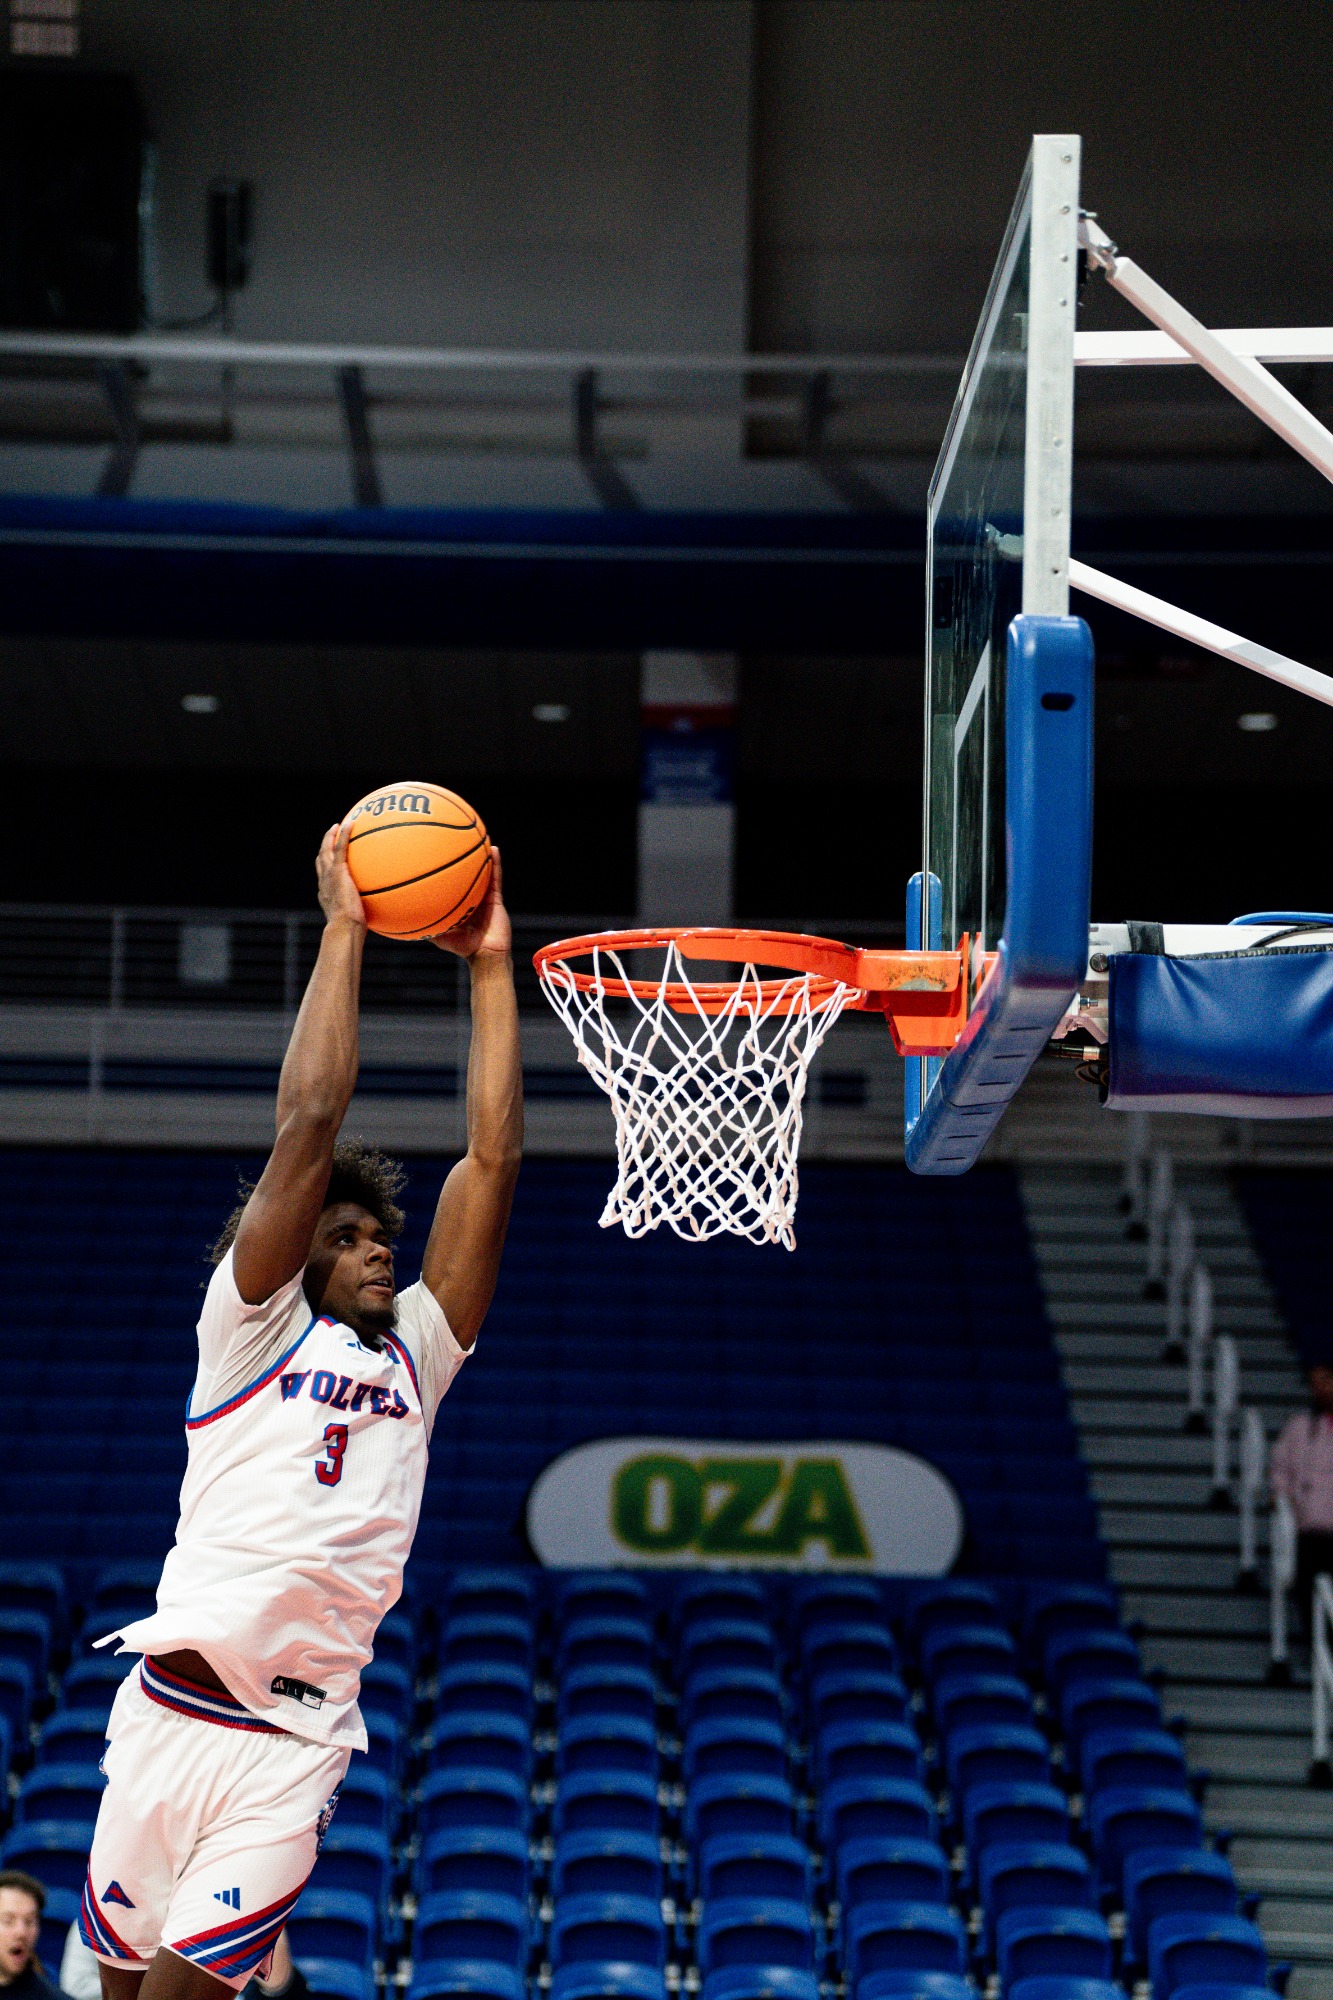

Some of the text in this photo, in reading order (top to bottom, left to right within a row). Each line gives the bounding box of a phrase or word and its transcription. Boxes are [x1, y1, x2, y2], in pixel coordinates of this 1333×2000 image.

[351, 793, 431, 821] Wilso
[279, 1369, 409, 1420] WOLVES
[314, 1423, 349, 1487] 3
[611, 1453, 873, 1561] OZA
